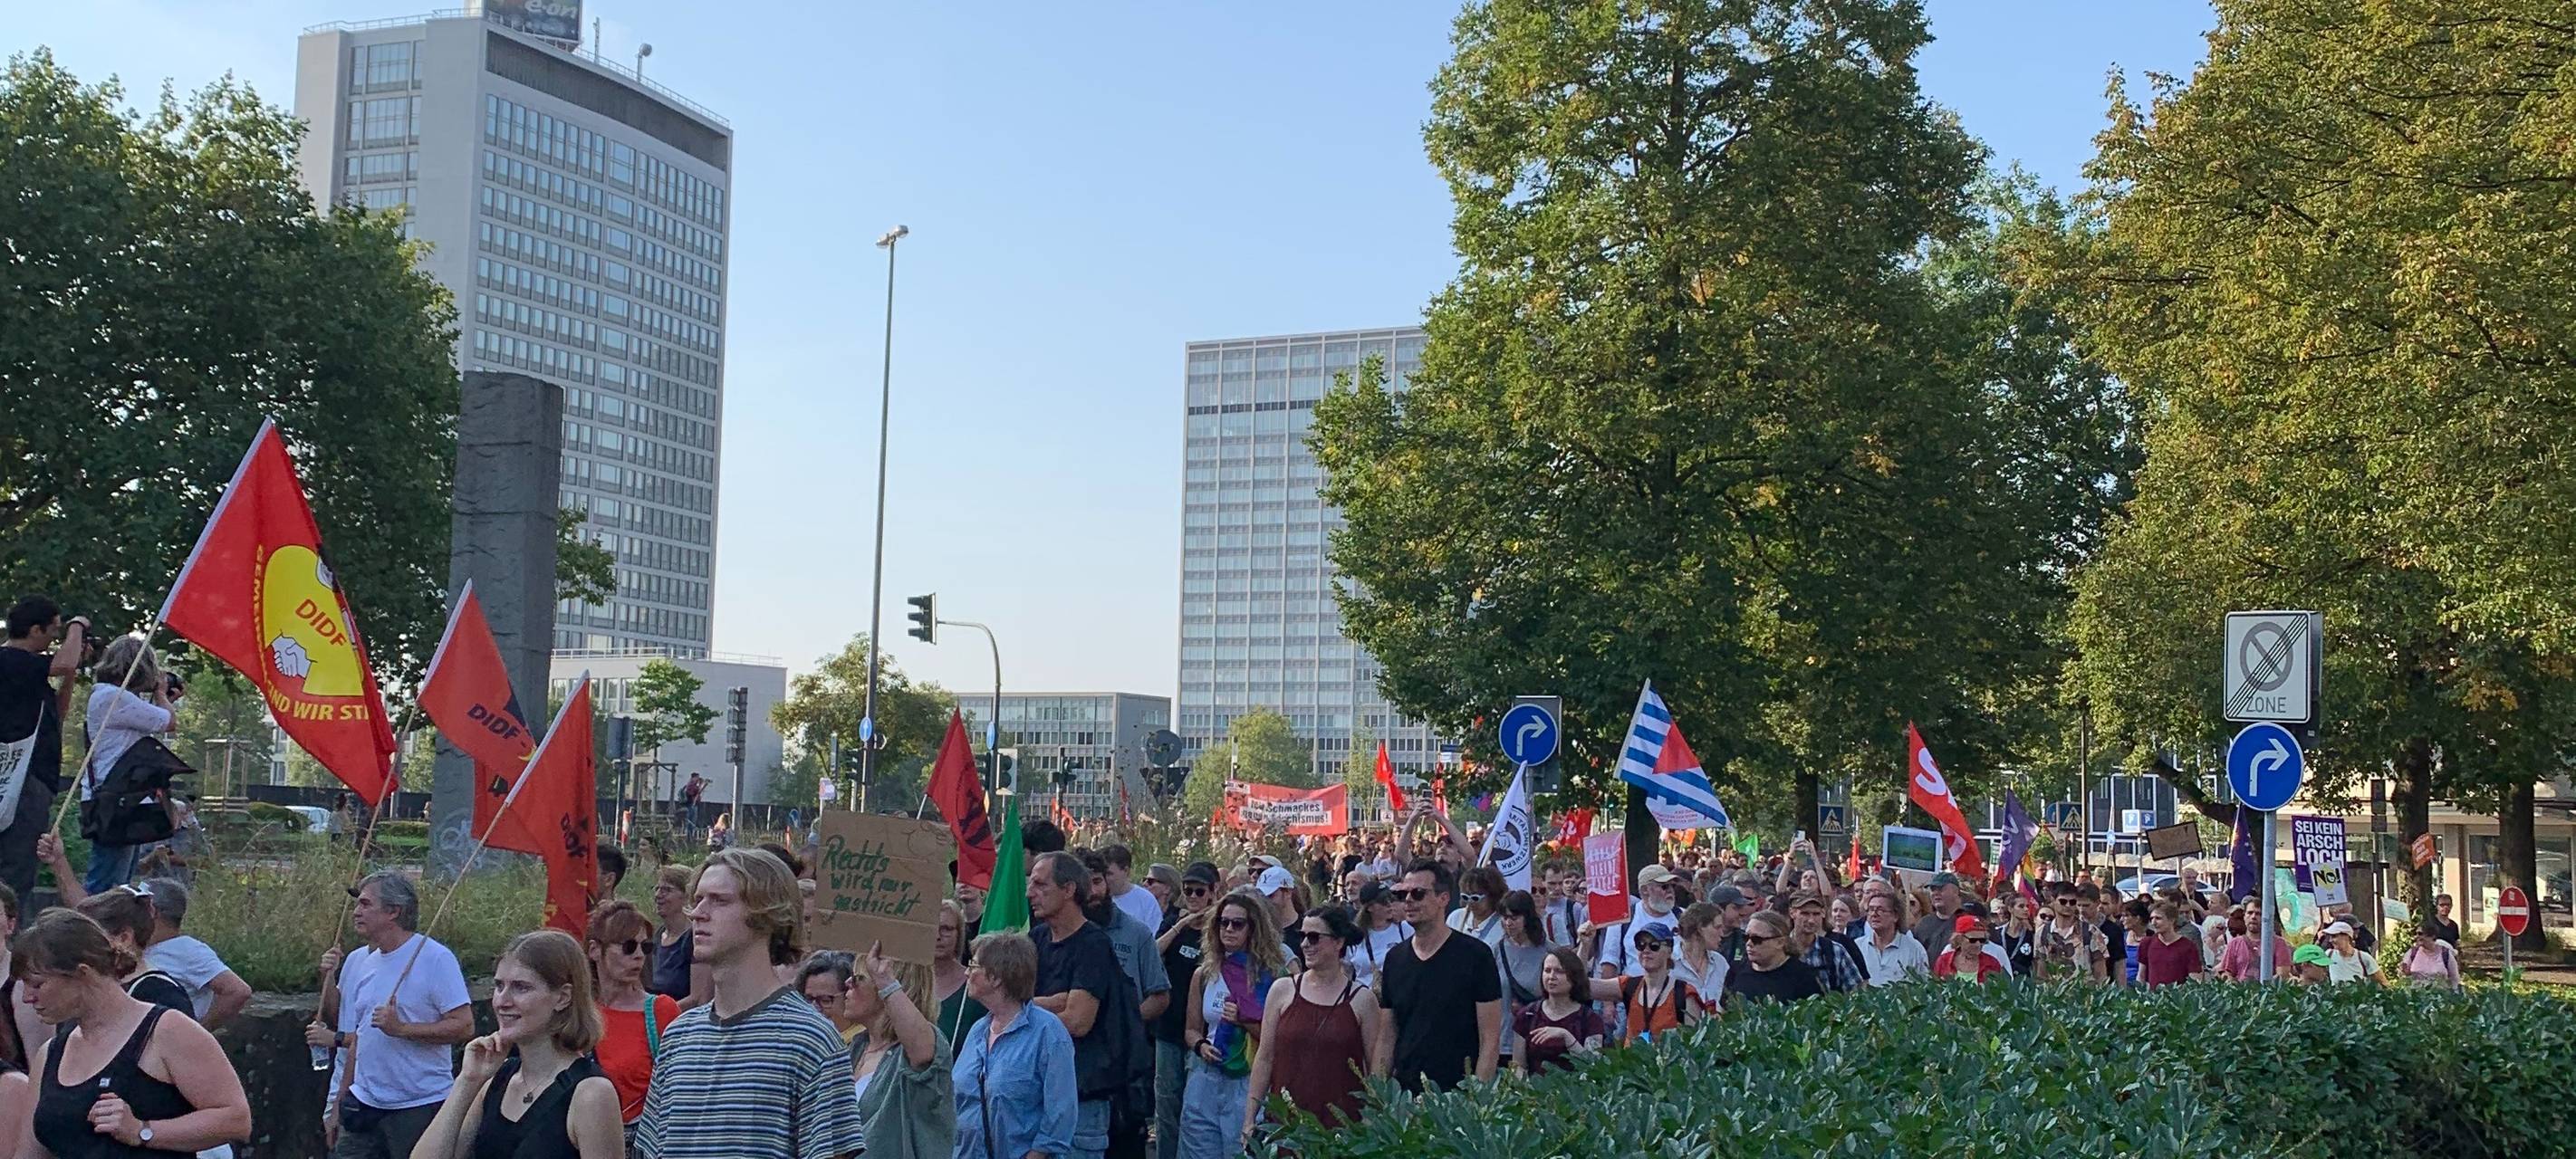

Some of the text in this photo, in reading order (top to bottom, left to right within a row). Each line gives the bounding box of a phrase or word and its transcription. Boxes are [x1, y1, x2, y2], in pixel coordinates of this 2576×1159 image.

[295, 599, 347, 647] DIDF
[293, 701, 333, 720] WIR
[2246, 696, 2287, 714] ZONE
[467, 704, 521, 740] DIDF
[1267, 803, 1321, 813] Schmackes
[2294, 820, 2343, 835] SEI KEIN
[2296, 834, 2343, 850] ARSCH
[2296, 847, 2345, 869] LOCH
